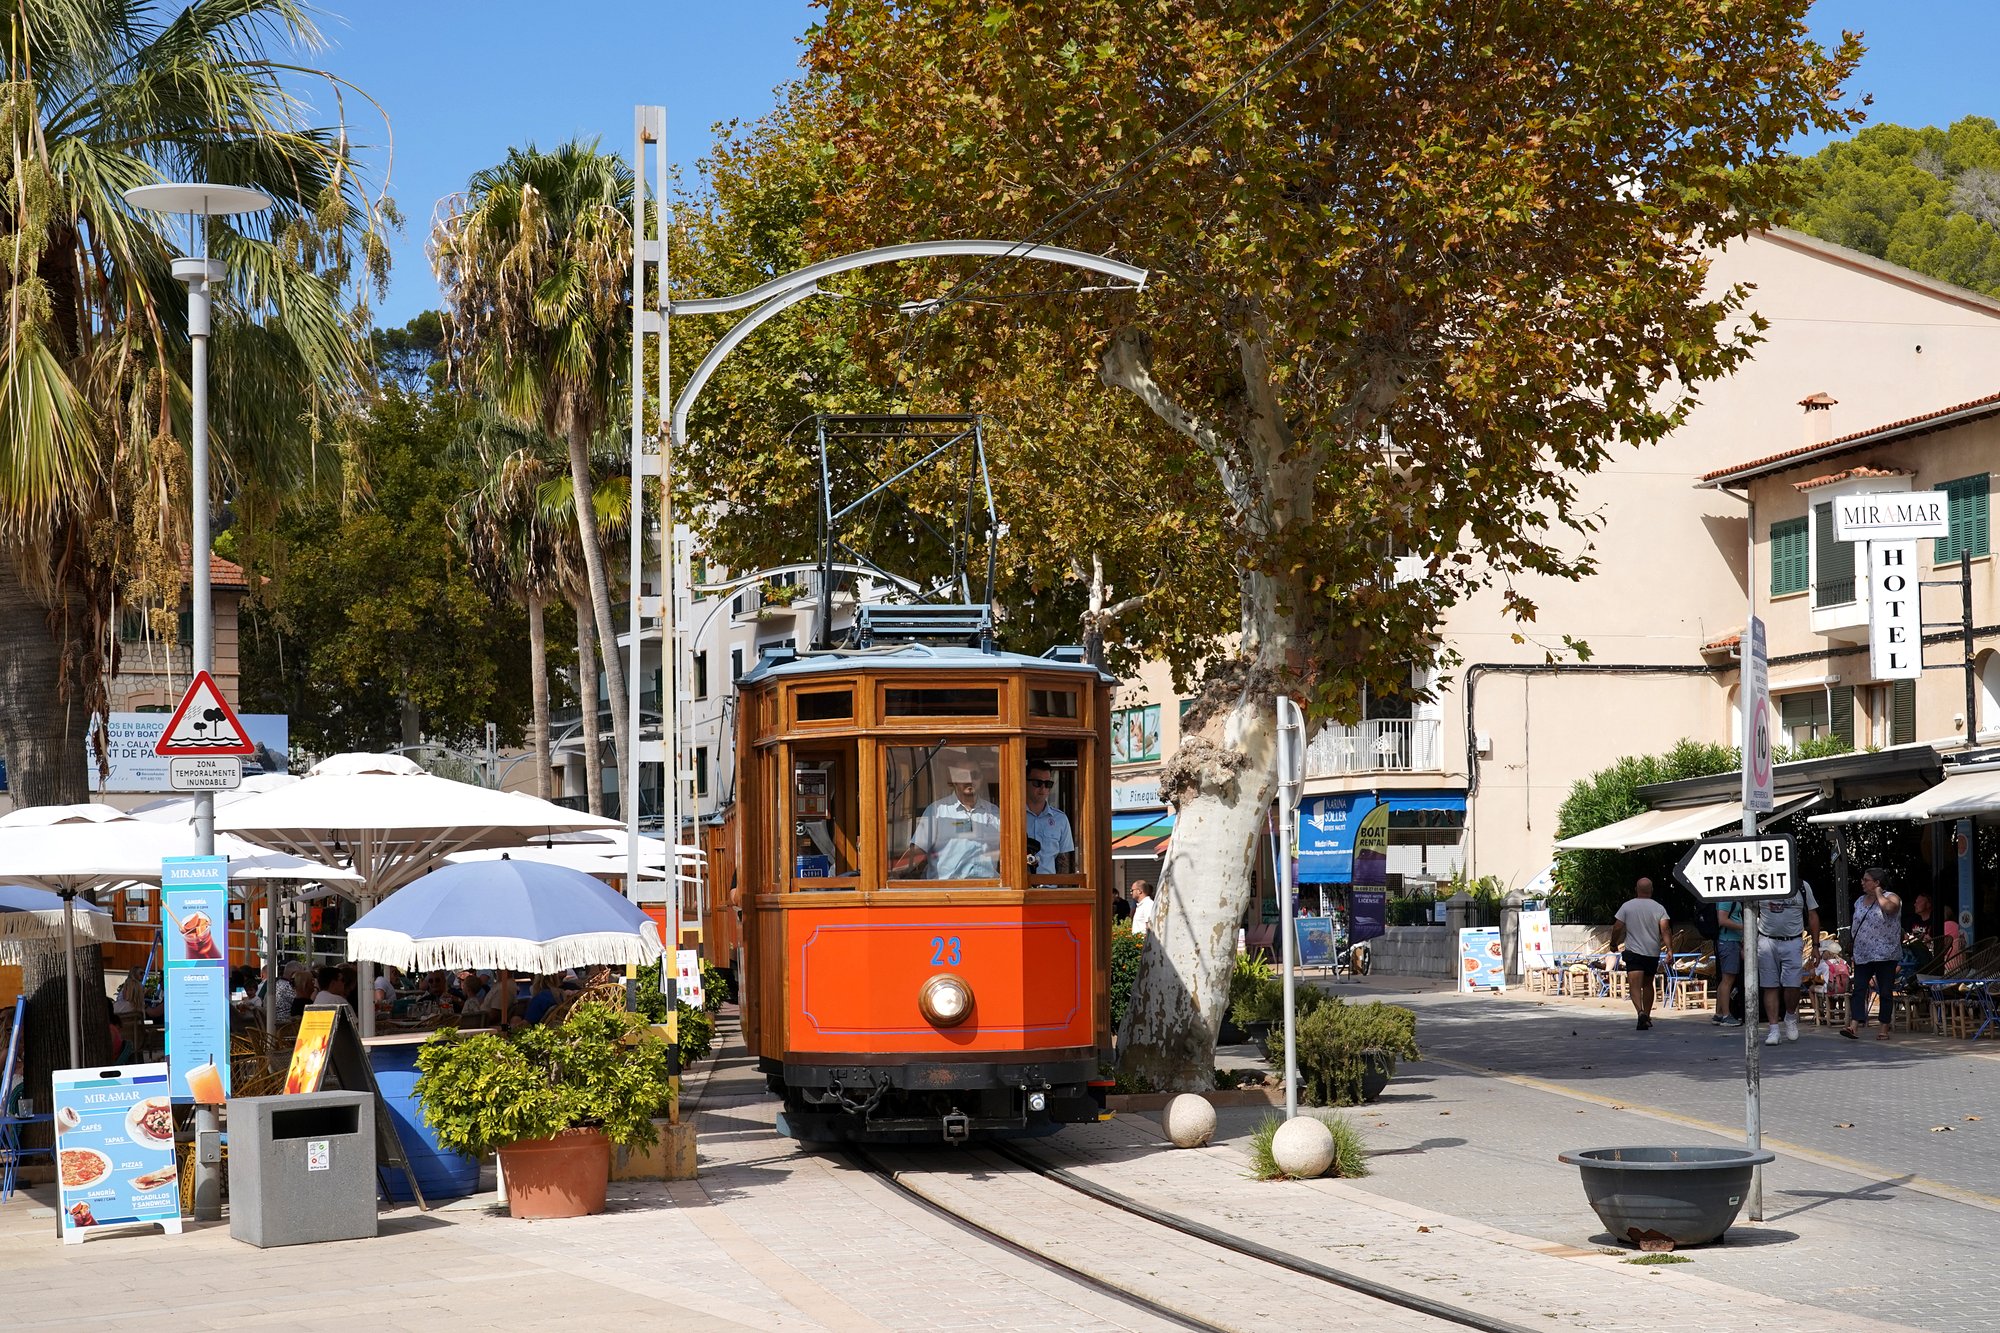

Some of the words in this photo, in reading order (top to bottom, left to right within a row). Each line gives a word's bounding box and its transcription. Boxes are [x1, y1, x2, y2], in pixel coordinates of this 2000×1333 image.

[1844, 503, 1941, 525] MIRAMAR
[1882, 549, 1907, 669] HOTEL
[1757, 725, 1766, 760] 10
[122, 749, 137, 758] DE
[1361, 827, 1386, 837] BOAT
[1703, 847, 1752, 865] MOLL
[1761, 845, 1785, 862] DE
[171, 868, 219, 878] MIRAMAR
[931, 936, 962, 966] 23
[84, 1091, 140, 1103] MIRAMAR
[81, 1123, 102, 1131] CAFÉS
[131, 1193, 170, 1202] BOCADILLOS
[137, 1200, 171, 1208] SANDWICH
